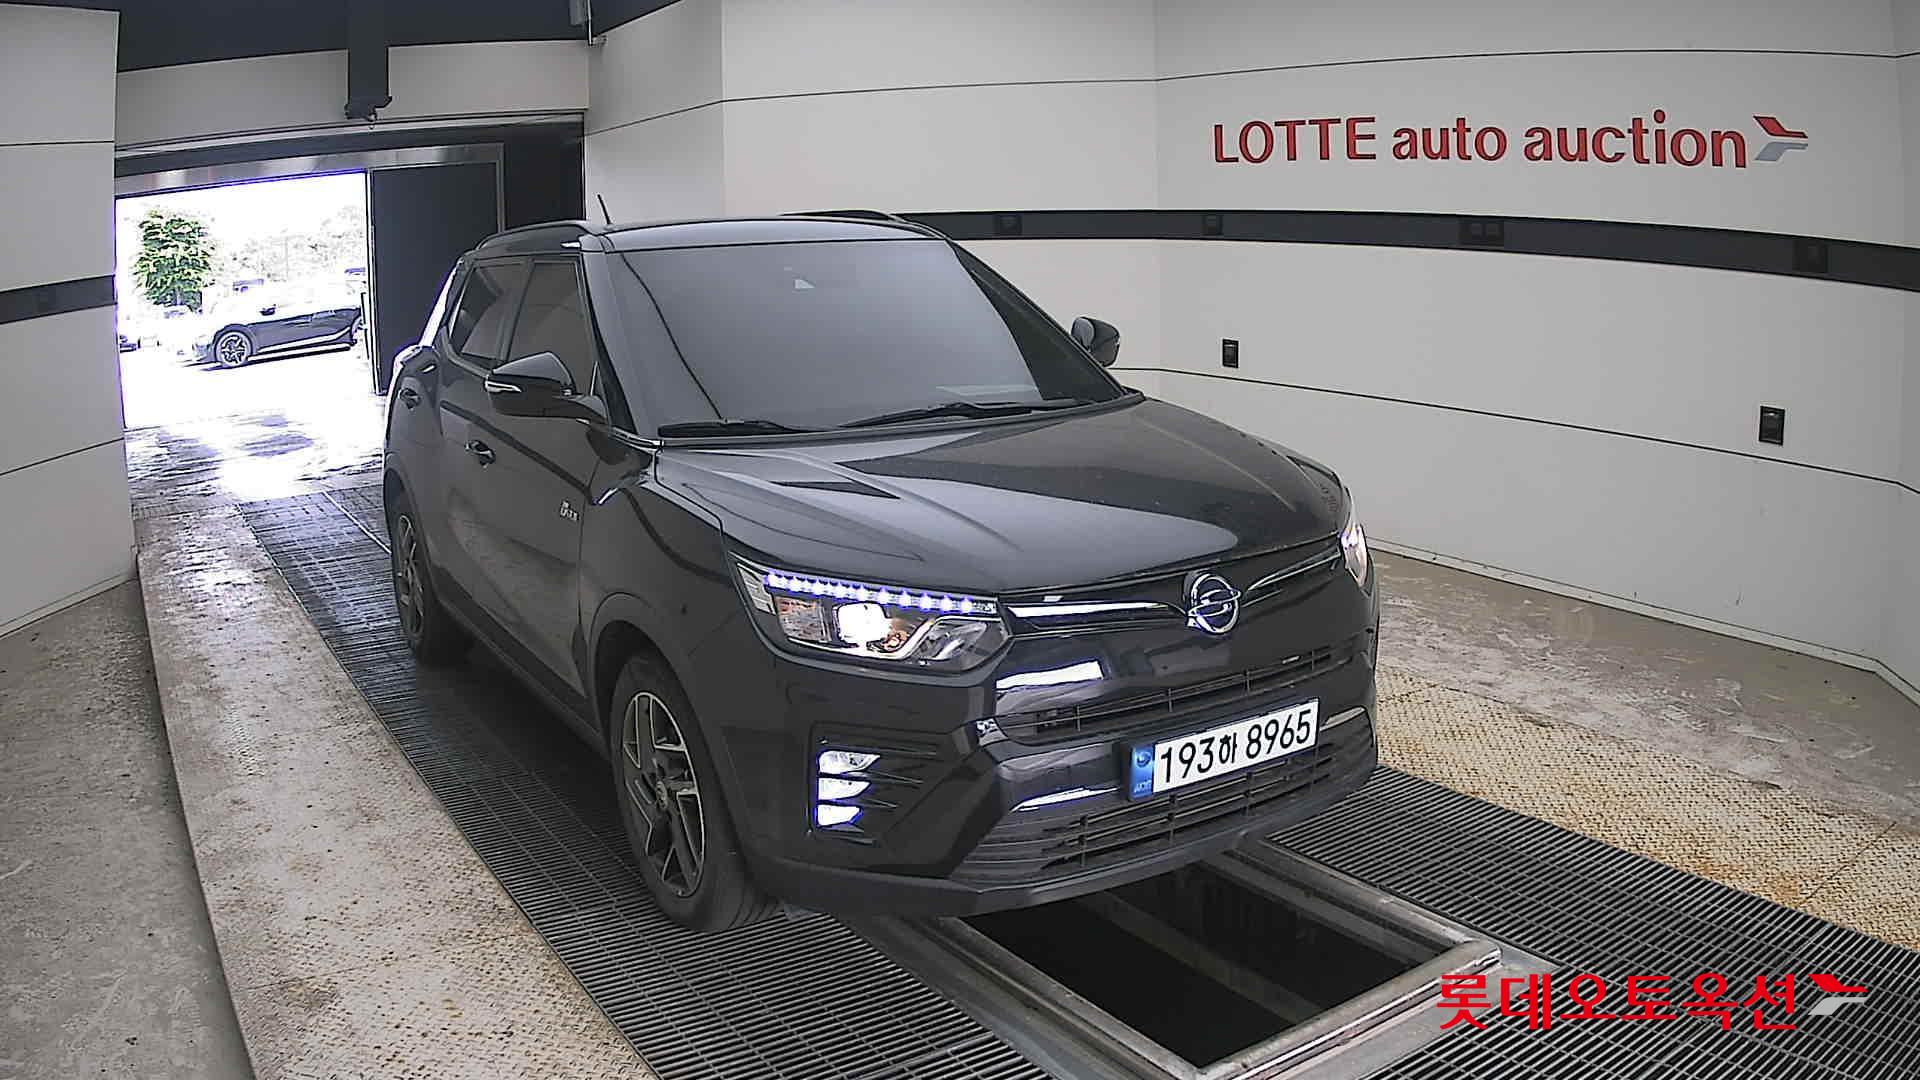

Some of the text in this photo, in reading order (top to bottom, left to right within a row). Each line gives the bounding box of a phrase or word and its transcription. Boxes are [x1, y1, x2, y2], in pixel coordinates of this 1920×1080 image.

[1213, 110, 1747, 169] LOTTE auto auction
[1160, 708, 1312, 783] 193하 8965
